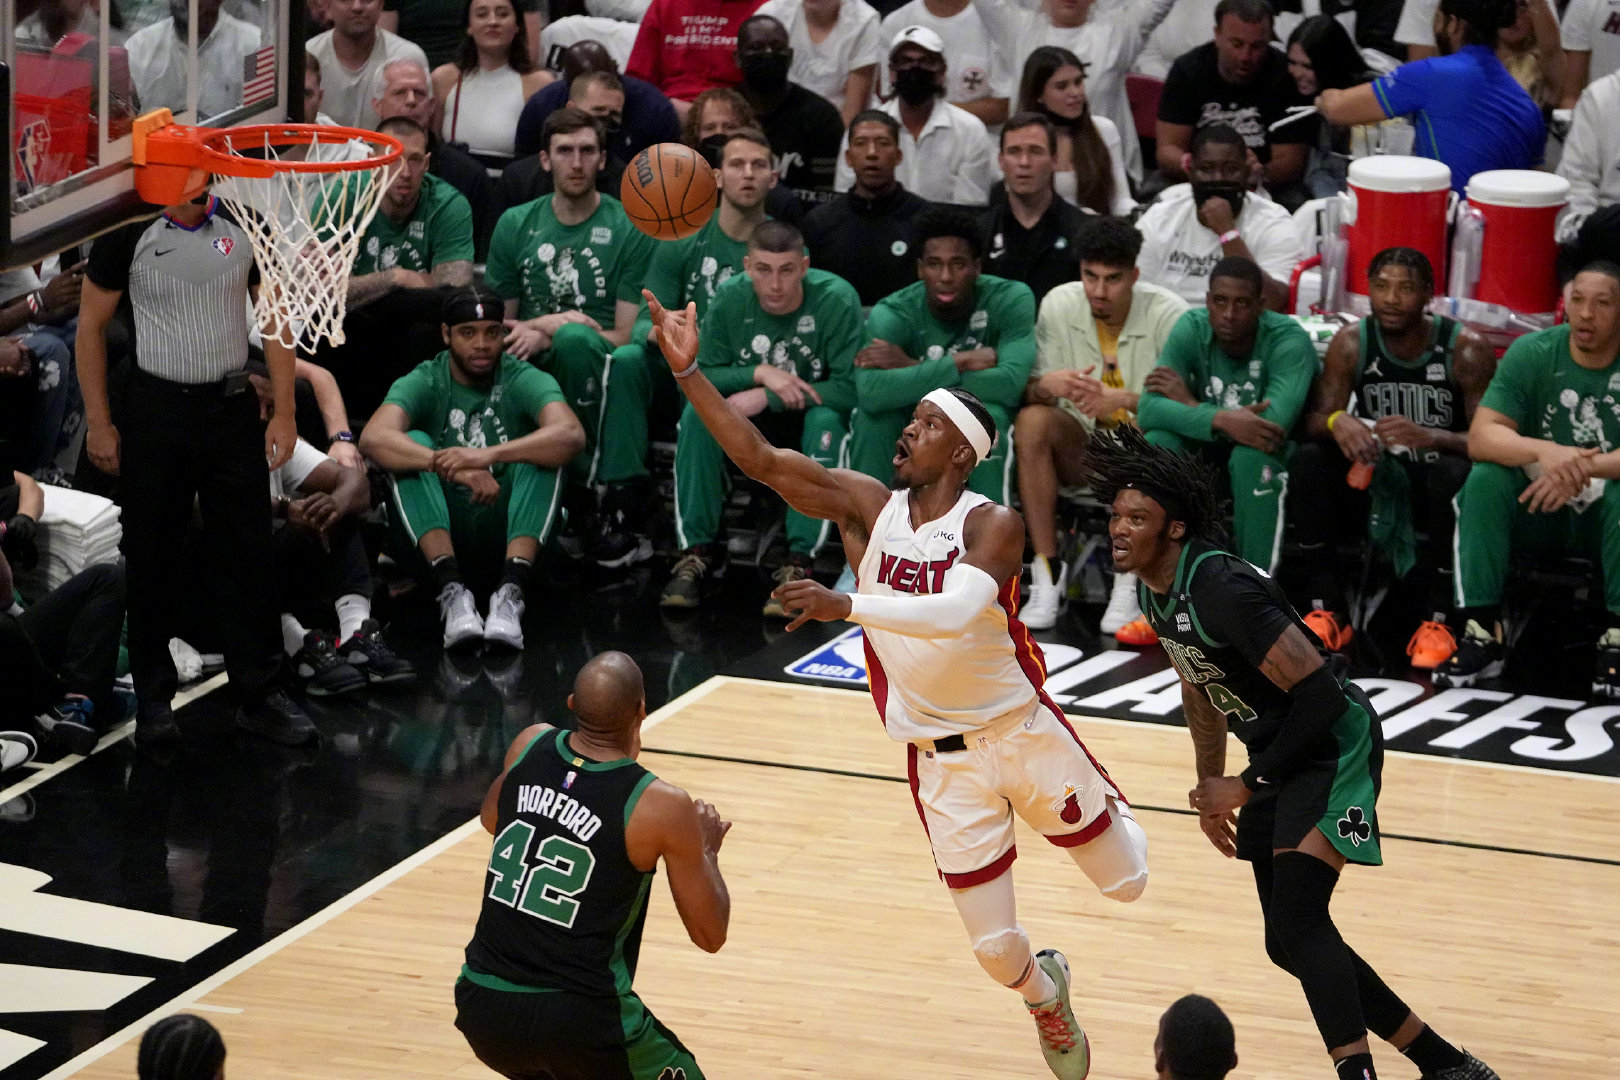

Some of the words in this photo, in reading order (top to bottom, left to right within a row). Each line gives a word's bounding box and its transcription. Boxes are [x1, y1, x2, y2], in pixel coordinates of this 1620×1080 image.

[681, 15, 729, 25] TRUMP
[580, 247, 607, 298] PRIDE
[1362, 381, 1453, 428] CELTICS
[876, 545, 960, 595] HEAT
[801, 662, 858, 678] NBA
[516, 784, 602, 842] HORFORD
[488, 818, 596, 929] 42
